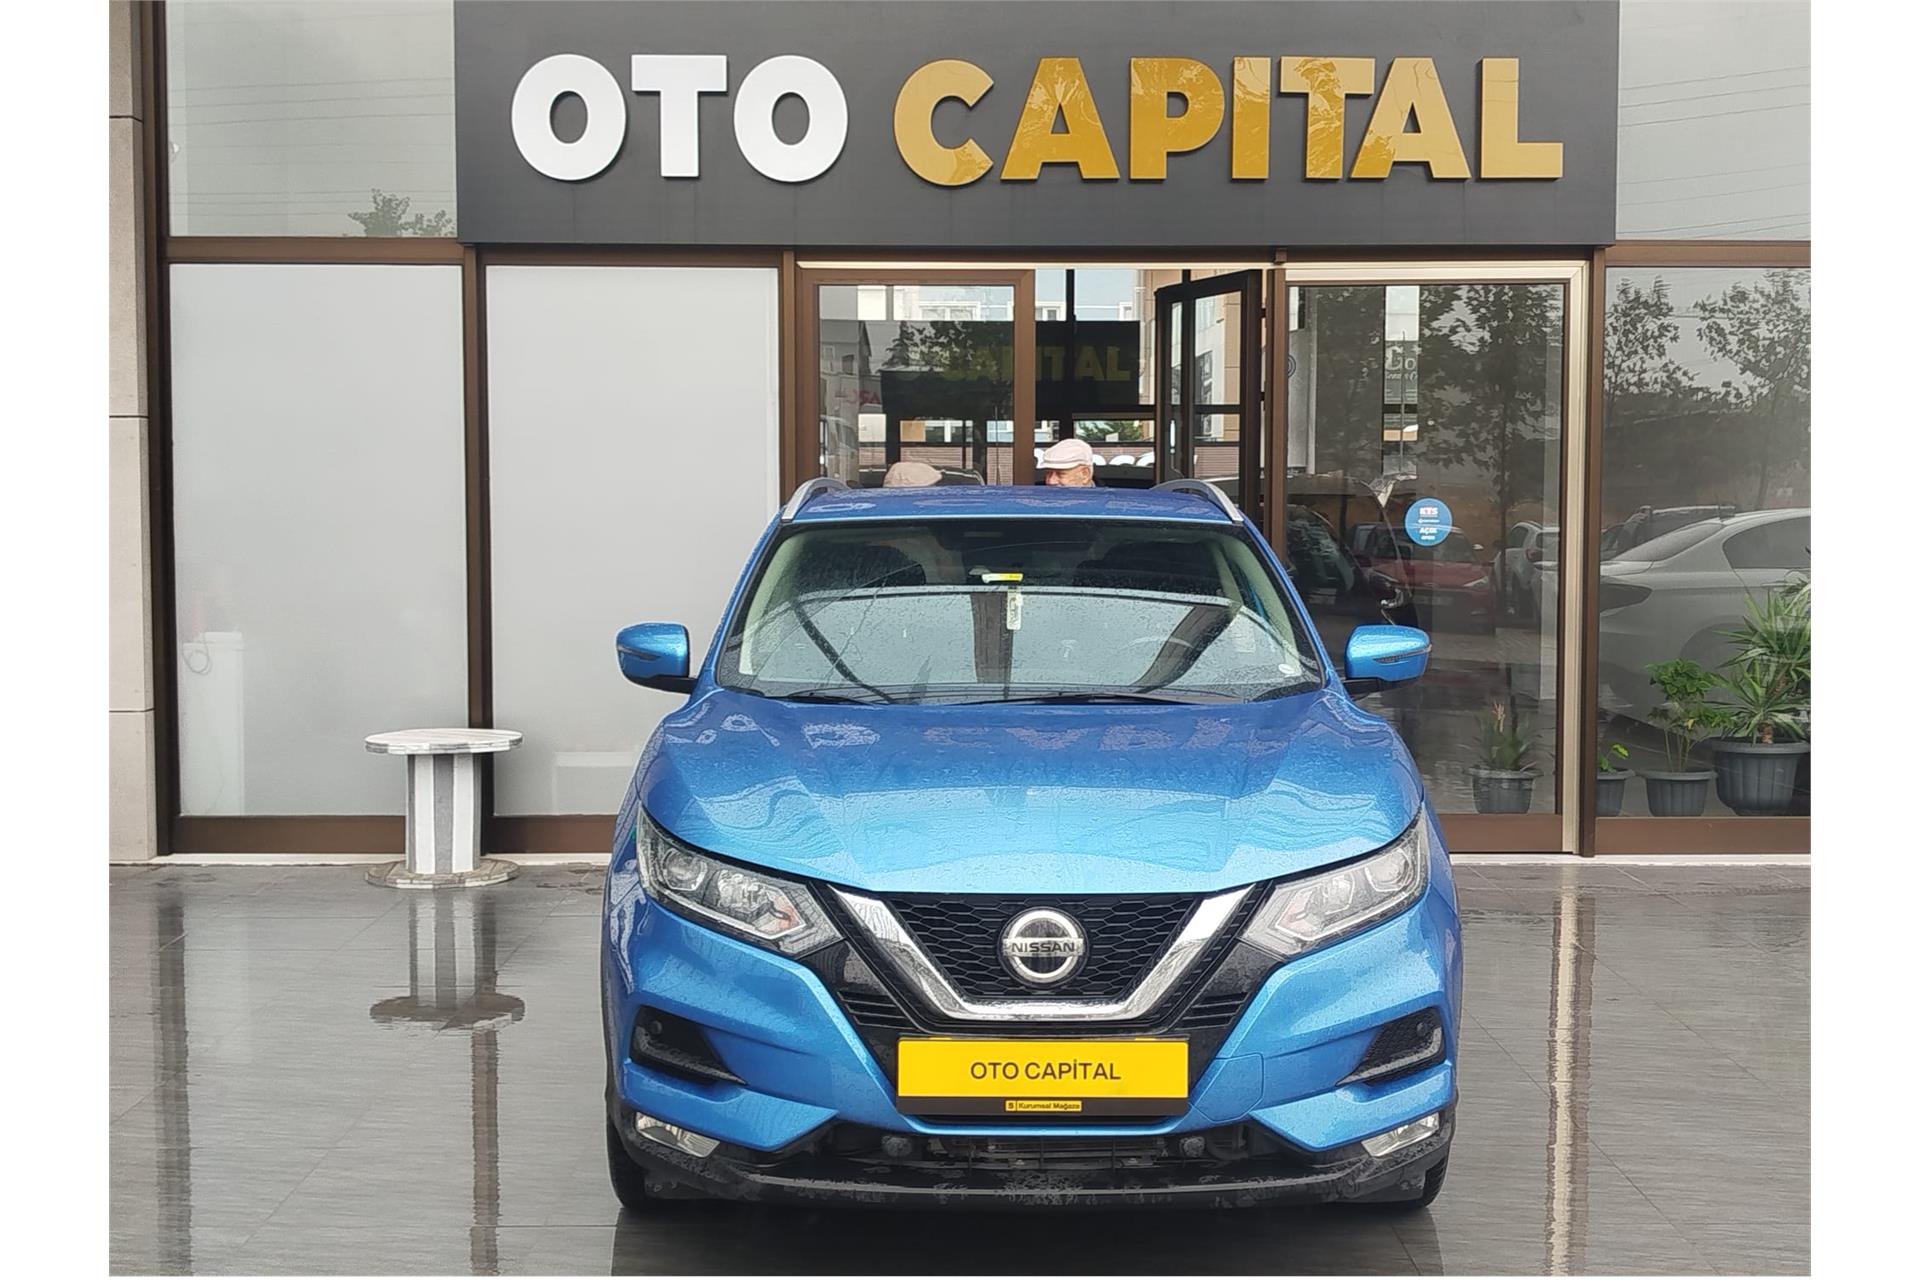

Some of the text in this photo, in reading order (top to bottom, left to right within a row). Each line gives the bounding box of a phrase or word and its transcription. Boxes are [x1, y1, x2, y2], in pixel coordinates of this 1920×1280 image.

[511, 53, 1564, 187] OTO CAPITAL
[1011, 942, 1075, 953] NISSAN
[970, 1058, 1121, 1080] OTO CAPİTAL
[1018, 1102, 1052, 1110] Kurumsal
